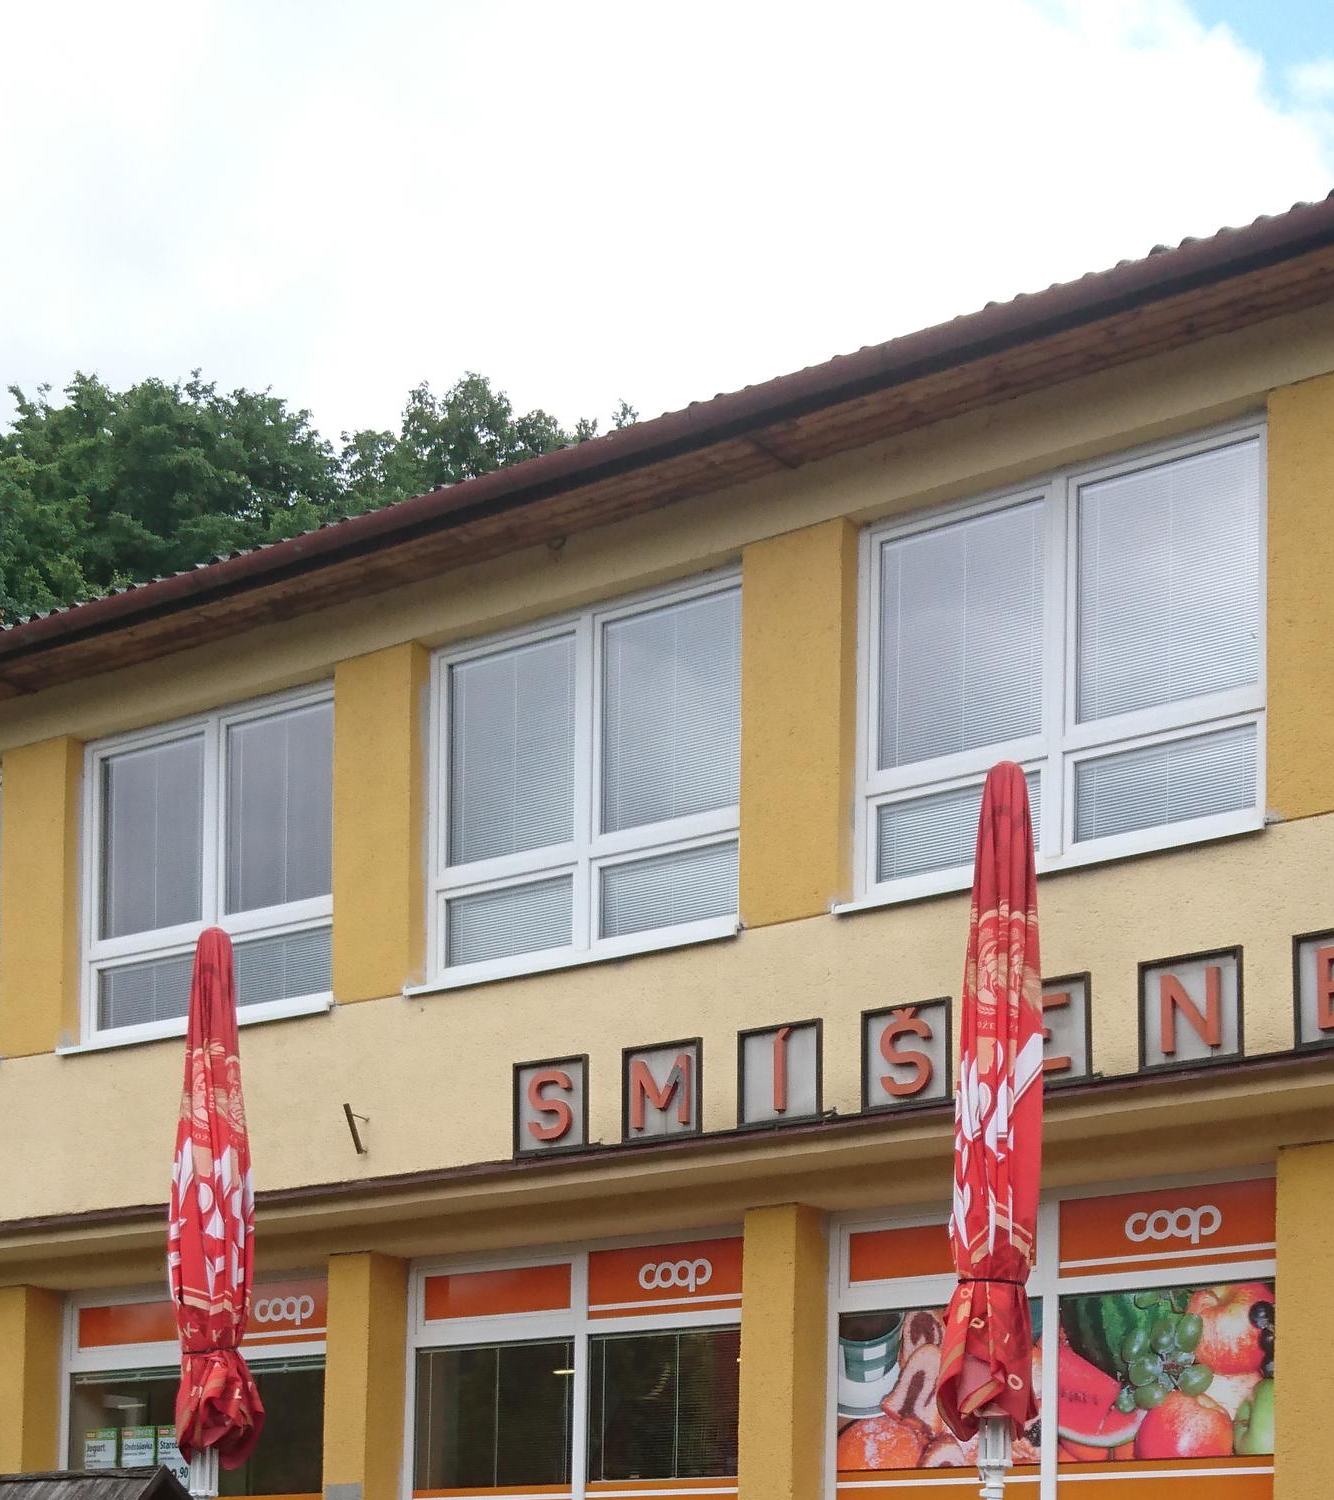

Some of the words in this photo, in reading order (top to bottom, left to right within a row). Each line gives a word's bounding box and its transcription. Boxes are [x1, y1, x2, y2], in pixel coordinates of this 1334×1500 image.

[1124, 1205, 1223, 1246] coop
[638, 1258, 713, 1293] coop
[254, 1294, 315, 1326] coop
